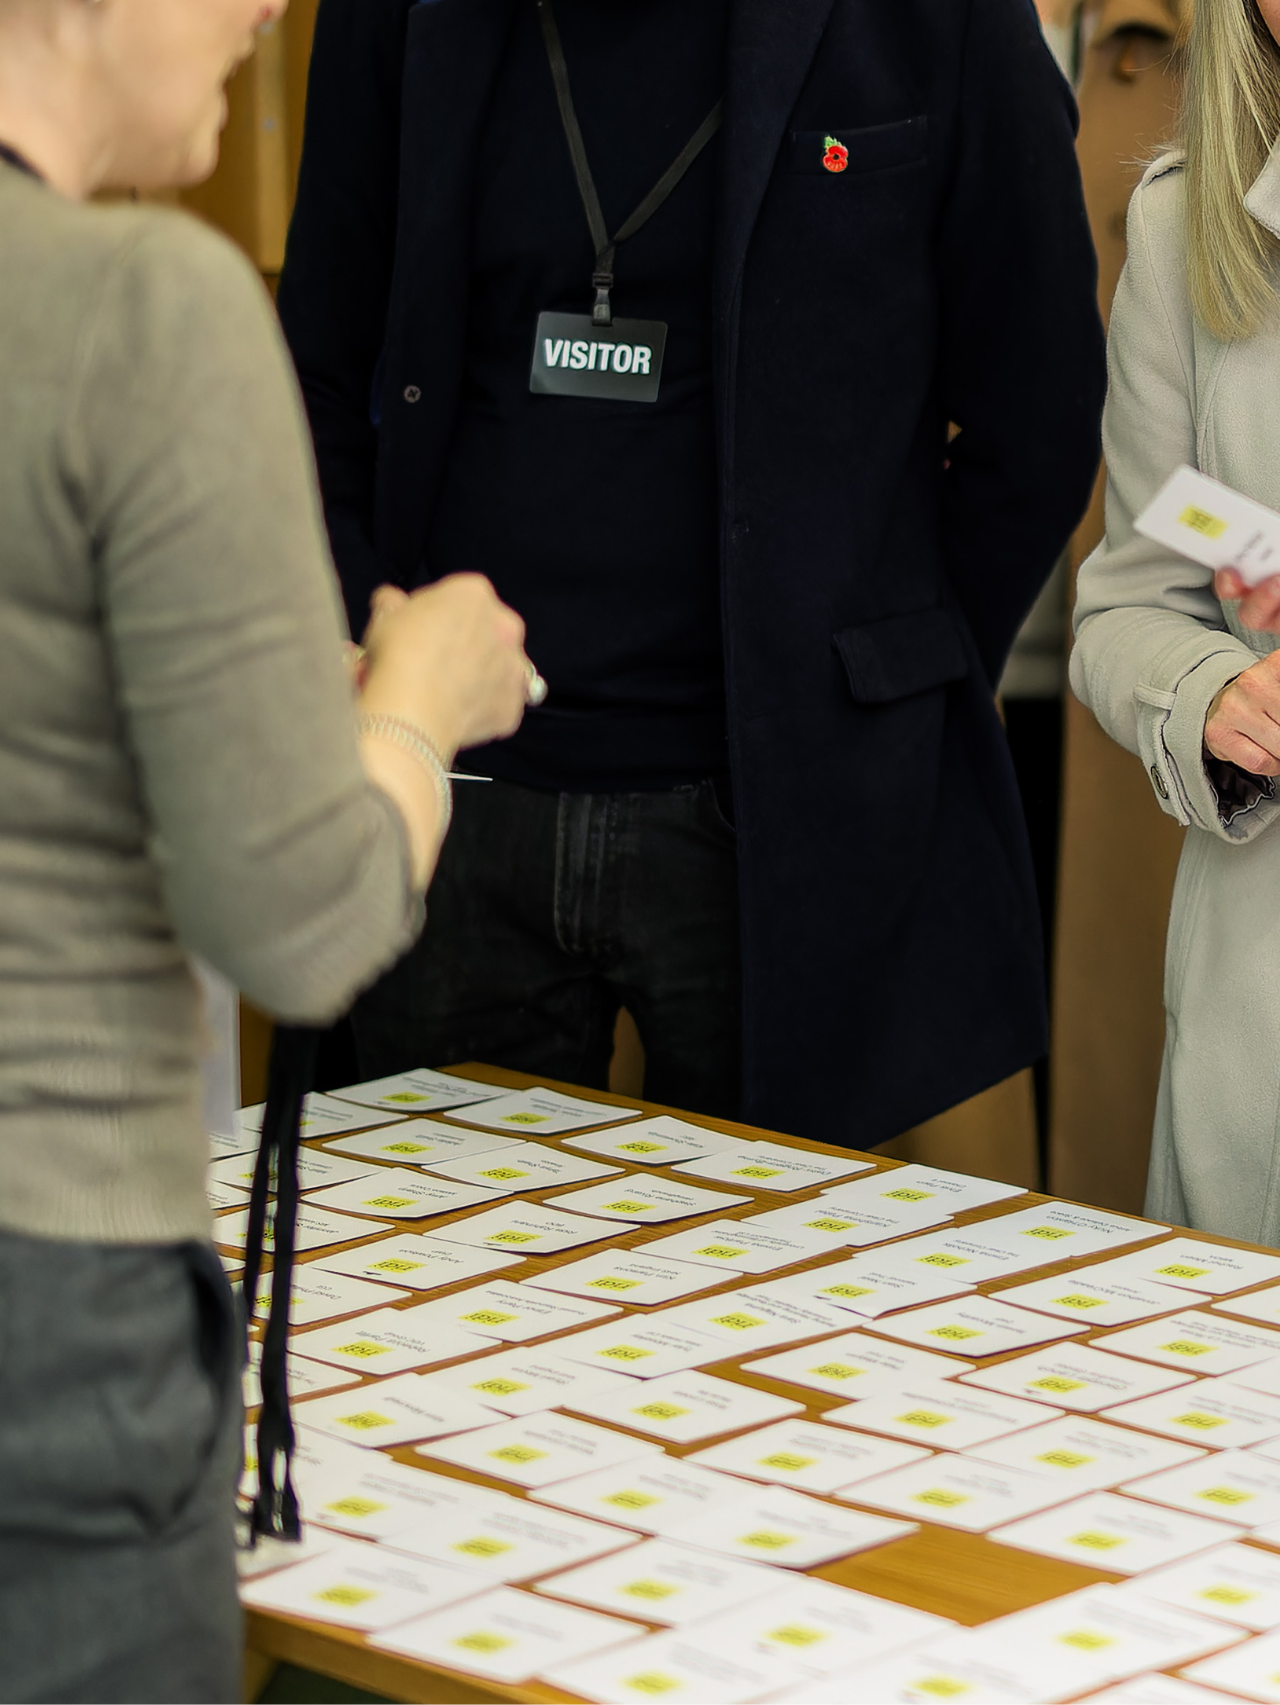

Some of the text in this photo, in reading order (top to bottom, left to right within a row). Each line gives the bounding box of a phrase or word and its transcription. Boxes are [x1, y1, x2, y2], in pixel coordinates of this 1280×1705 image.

[544, 338, 652, 375] VISITOR
[732, 1168, 775, 1177] ridi
[884, 1191, 924, 1200] ridi
[363, 1198, 409, 1207] ridi
[603, 1202, 646, 1212] ridi
[806, 1220, 848, 1230] ridi
[488, 1233, 532, 1242] ridi
[1024, 1229, 1065, 1238] ridi
[695, 1247, 740, 1257] ridi
[371, 1261, 415, 1271] ridi
[918, 1256, 960, 1266] ridi
[1156, 1267, 1202, 1277] ridi
[587, 1279, 634, 1289] ridi
[461, 1313, 508, 1323] ridi
